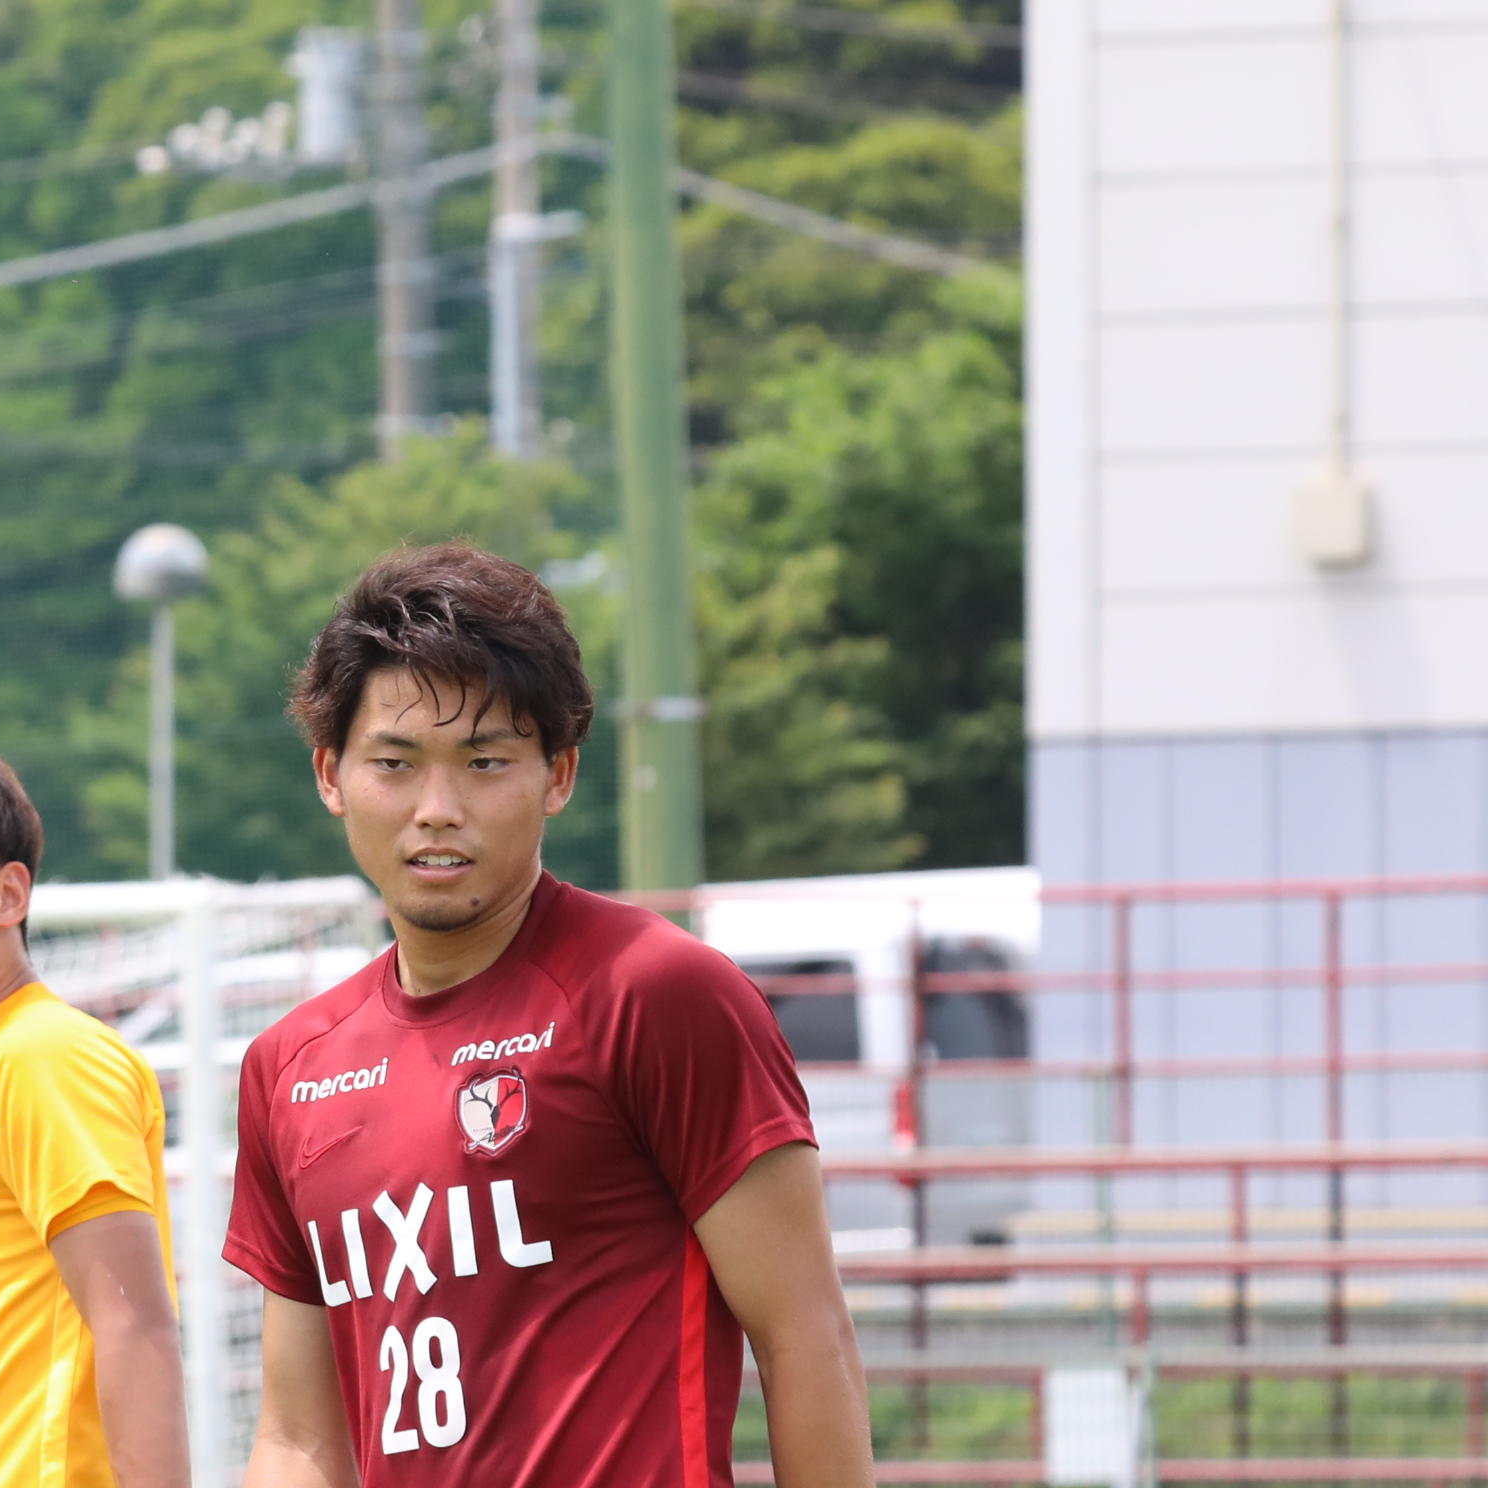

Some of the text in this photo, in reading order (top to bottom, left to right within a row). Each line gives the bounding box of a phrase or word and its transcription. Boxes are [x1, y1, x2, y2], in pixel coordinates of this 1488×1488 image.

[291, 1057, 389, 1104] mercari
[451, 1021, 556, 1066] mercari
[308, 1178, 554, 1308] LIXIL
[379, 1315, 468, 1456] 28
